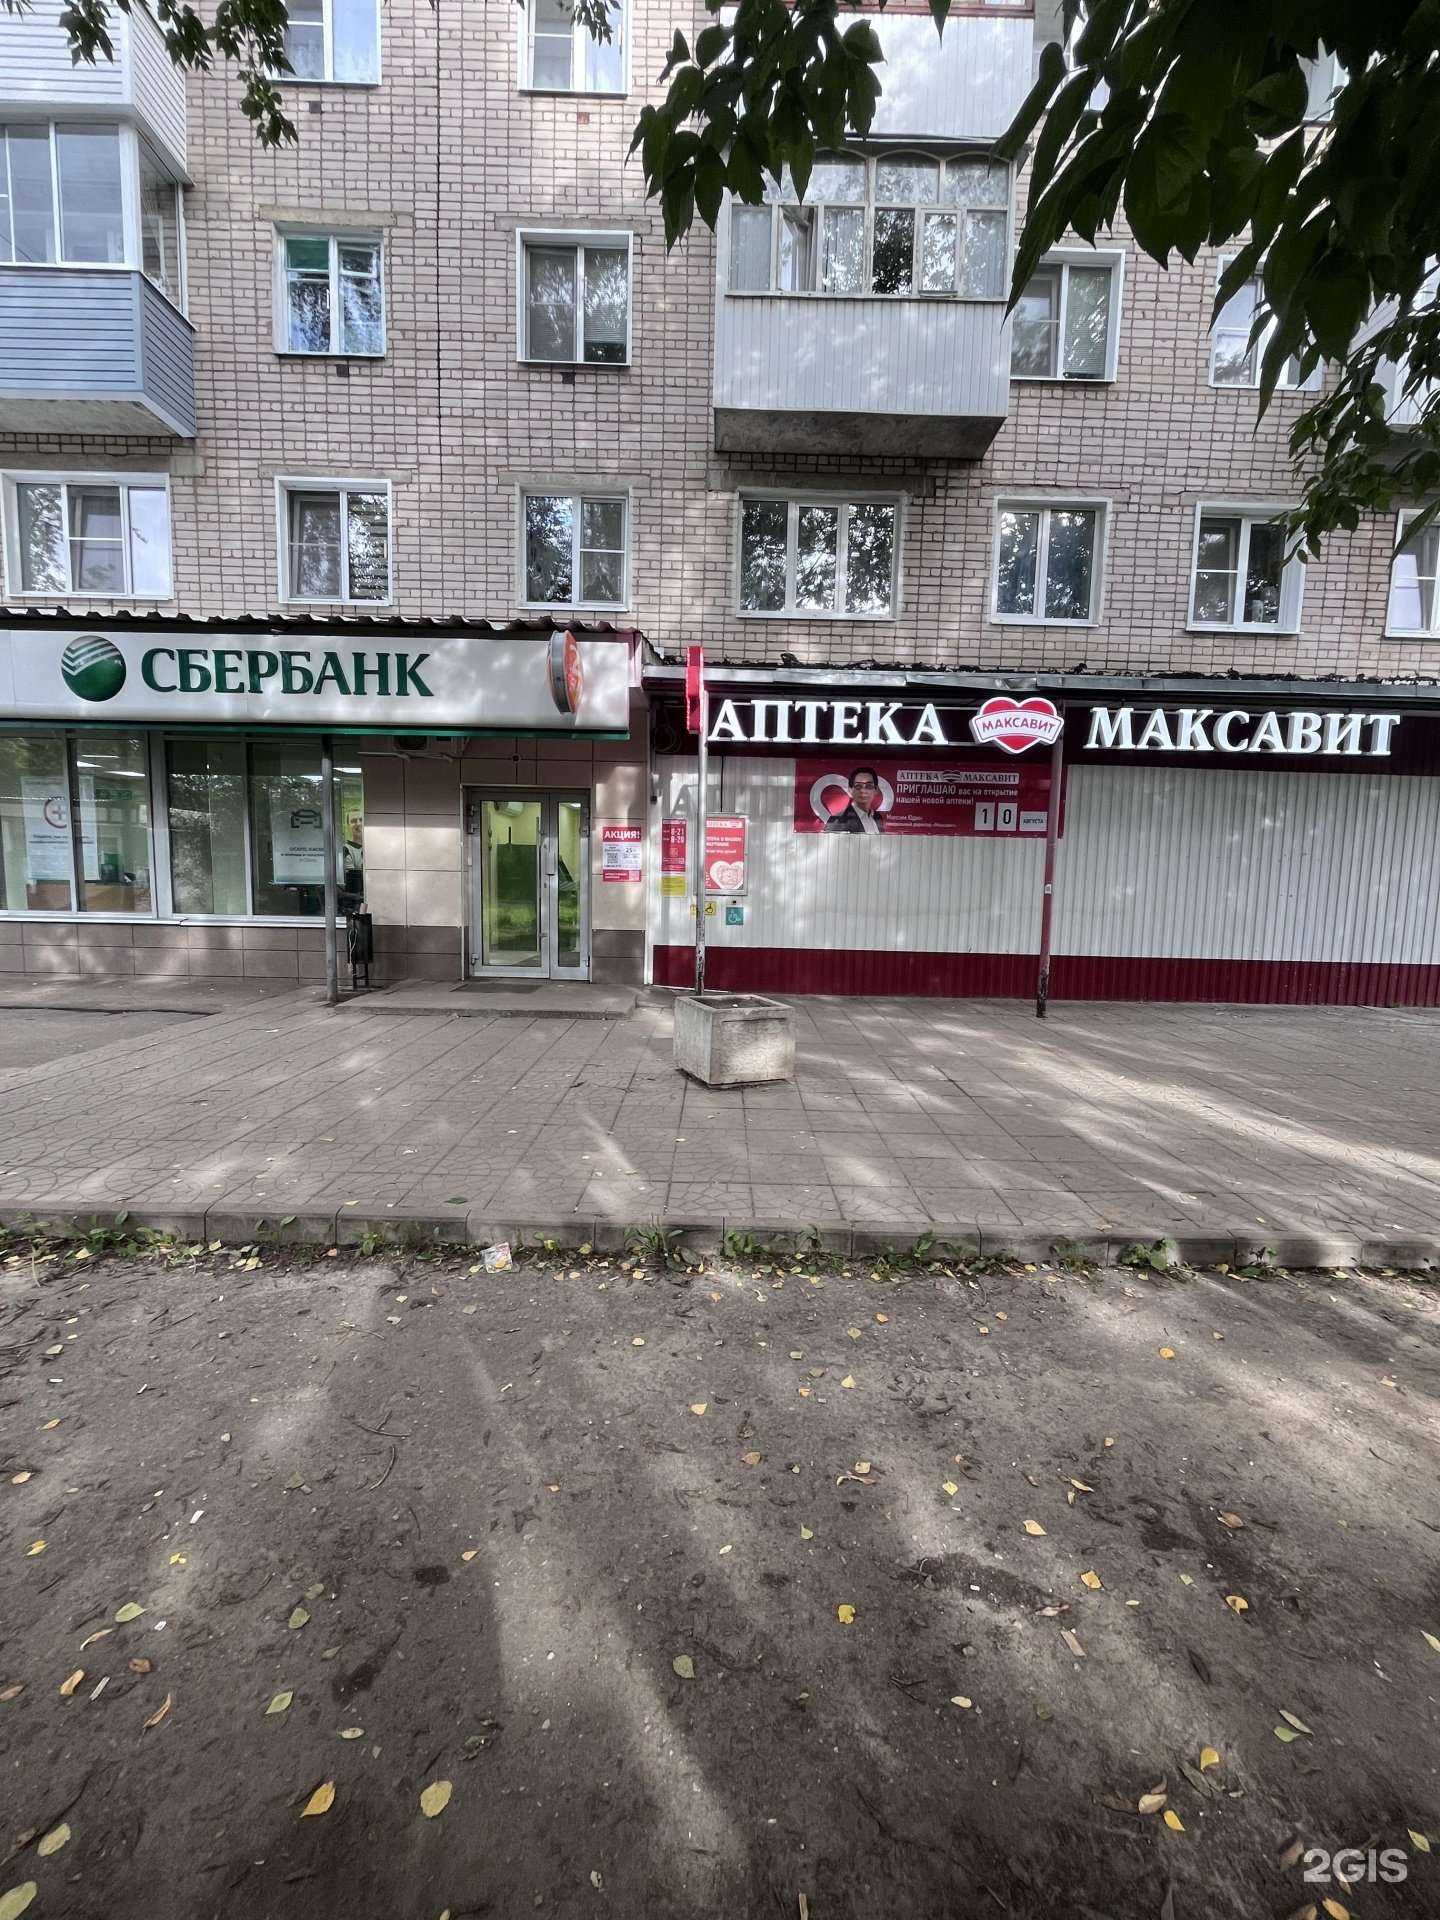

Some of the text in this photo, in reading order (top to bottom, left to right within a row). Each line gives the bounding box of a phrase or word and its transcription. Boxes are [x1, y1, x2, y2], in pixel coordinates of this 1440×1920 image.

[141, 647, 434, 696] СБЕРБАНК
[707, 699, 949, 745] АПТЕКА
[982, 717, 1057, 733] МАКСАВИТ
[1083, 707, 1400, 756] МАКСАВИТ
[899, 771, 1019, 784] АПТЕКА МАКСАВИТ
[896, 783, 957, 795] ПРИГЛАШАЮ
[983, 789, 1019, 797] открытие
[896, 796, 974, 806] нашей новой аптеки!
[982, 808, 988, 825] 1
[1003, 808, 1012, 825] 0
[604, 830, 641, 840] АКЦИЯ!
